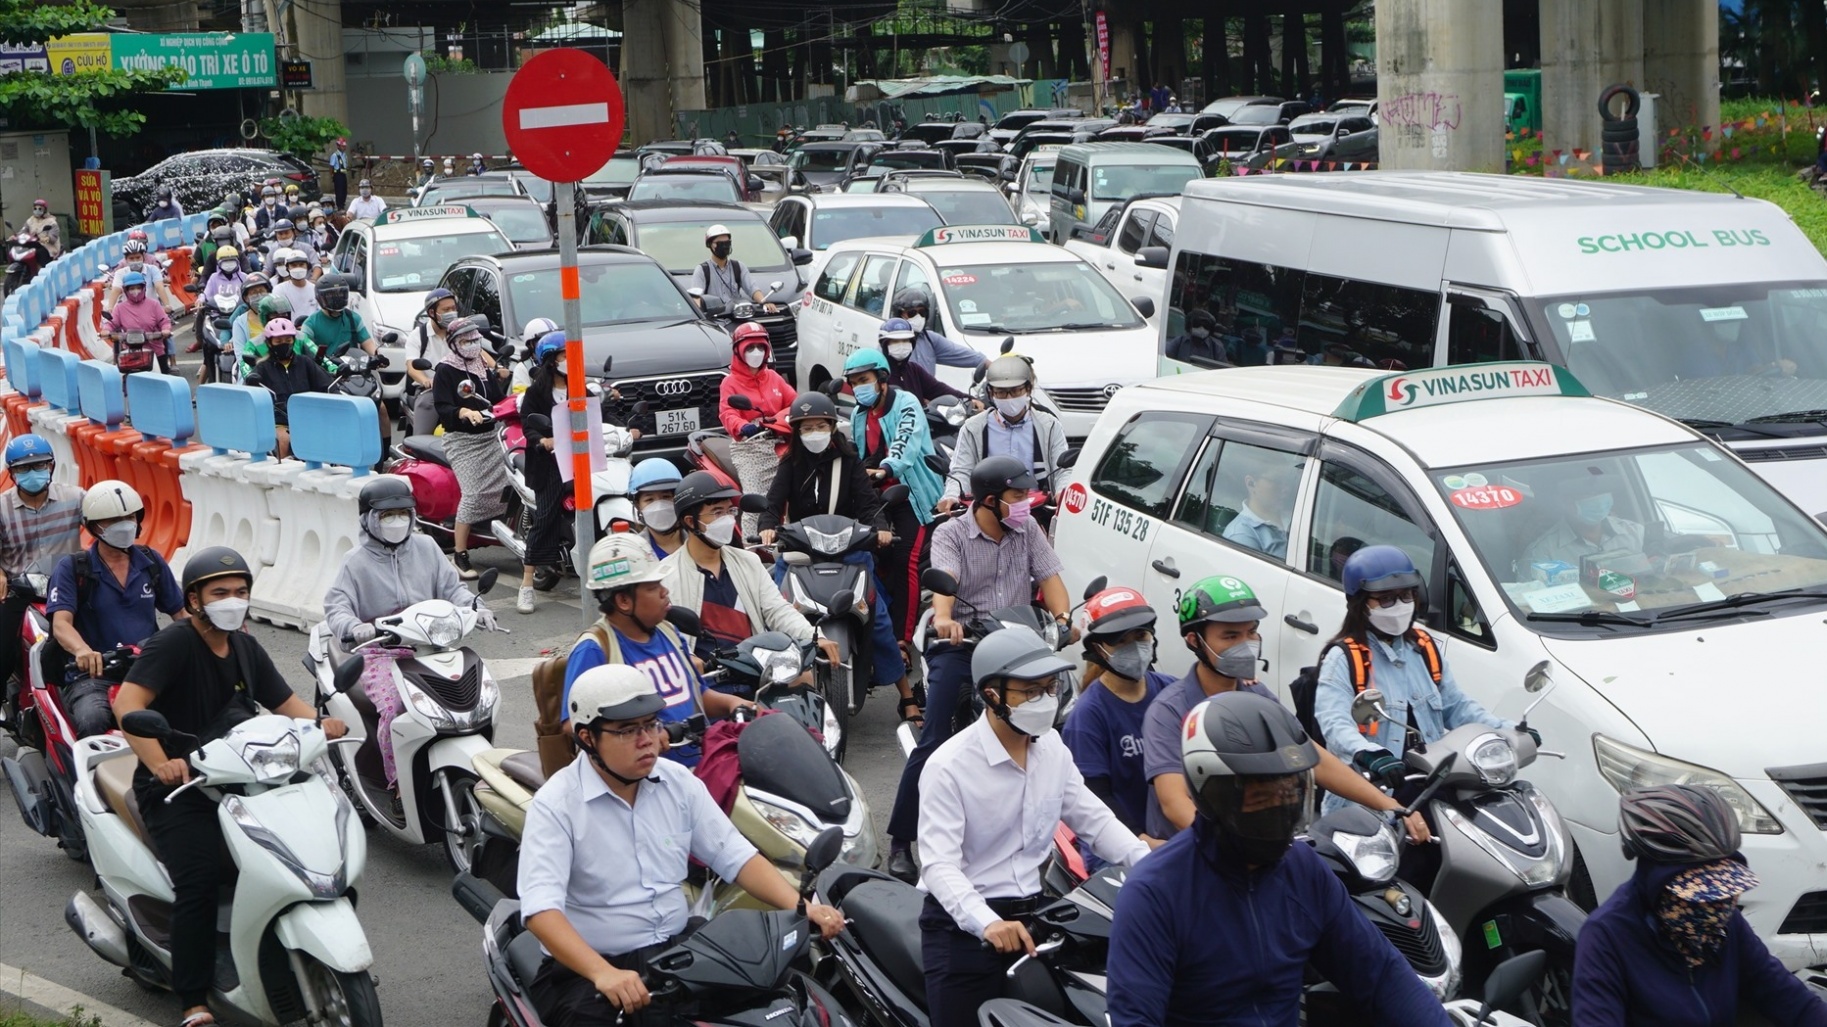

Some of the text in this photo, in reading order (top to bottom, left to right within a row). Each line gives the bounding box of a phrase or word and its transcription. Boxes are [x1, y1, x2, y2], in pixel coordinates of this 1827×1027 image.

[76, 52, 108, 67] CỨU HỘ
[200, 48, 220, 75] TRÌ
[223, 54, 239, 75] XE
[241, 50, 250, 74] Ô
[253, 50, 268, 74] TÔ
[81, 172, 97, 187] SỬA
[957, 229, 1029, 239] VINASUN TAXI
[1577, 229, 1771, 254] SCHOOL BUS
[668, 411, 687, 422] 51K
[661, 421, 696, 434] 267.60
[1454, 489, 1515, 506] 14370
[1091, 498, 1150, 541] 51F 135 28
